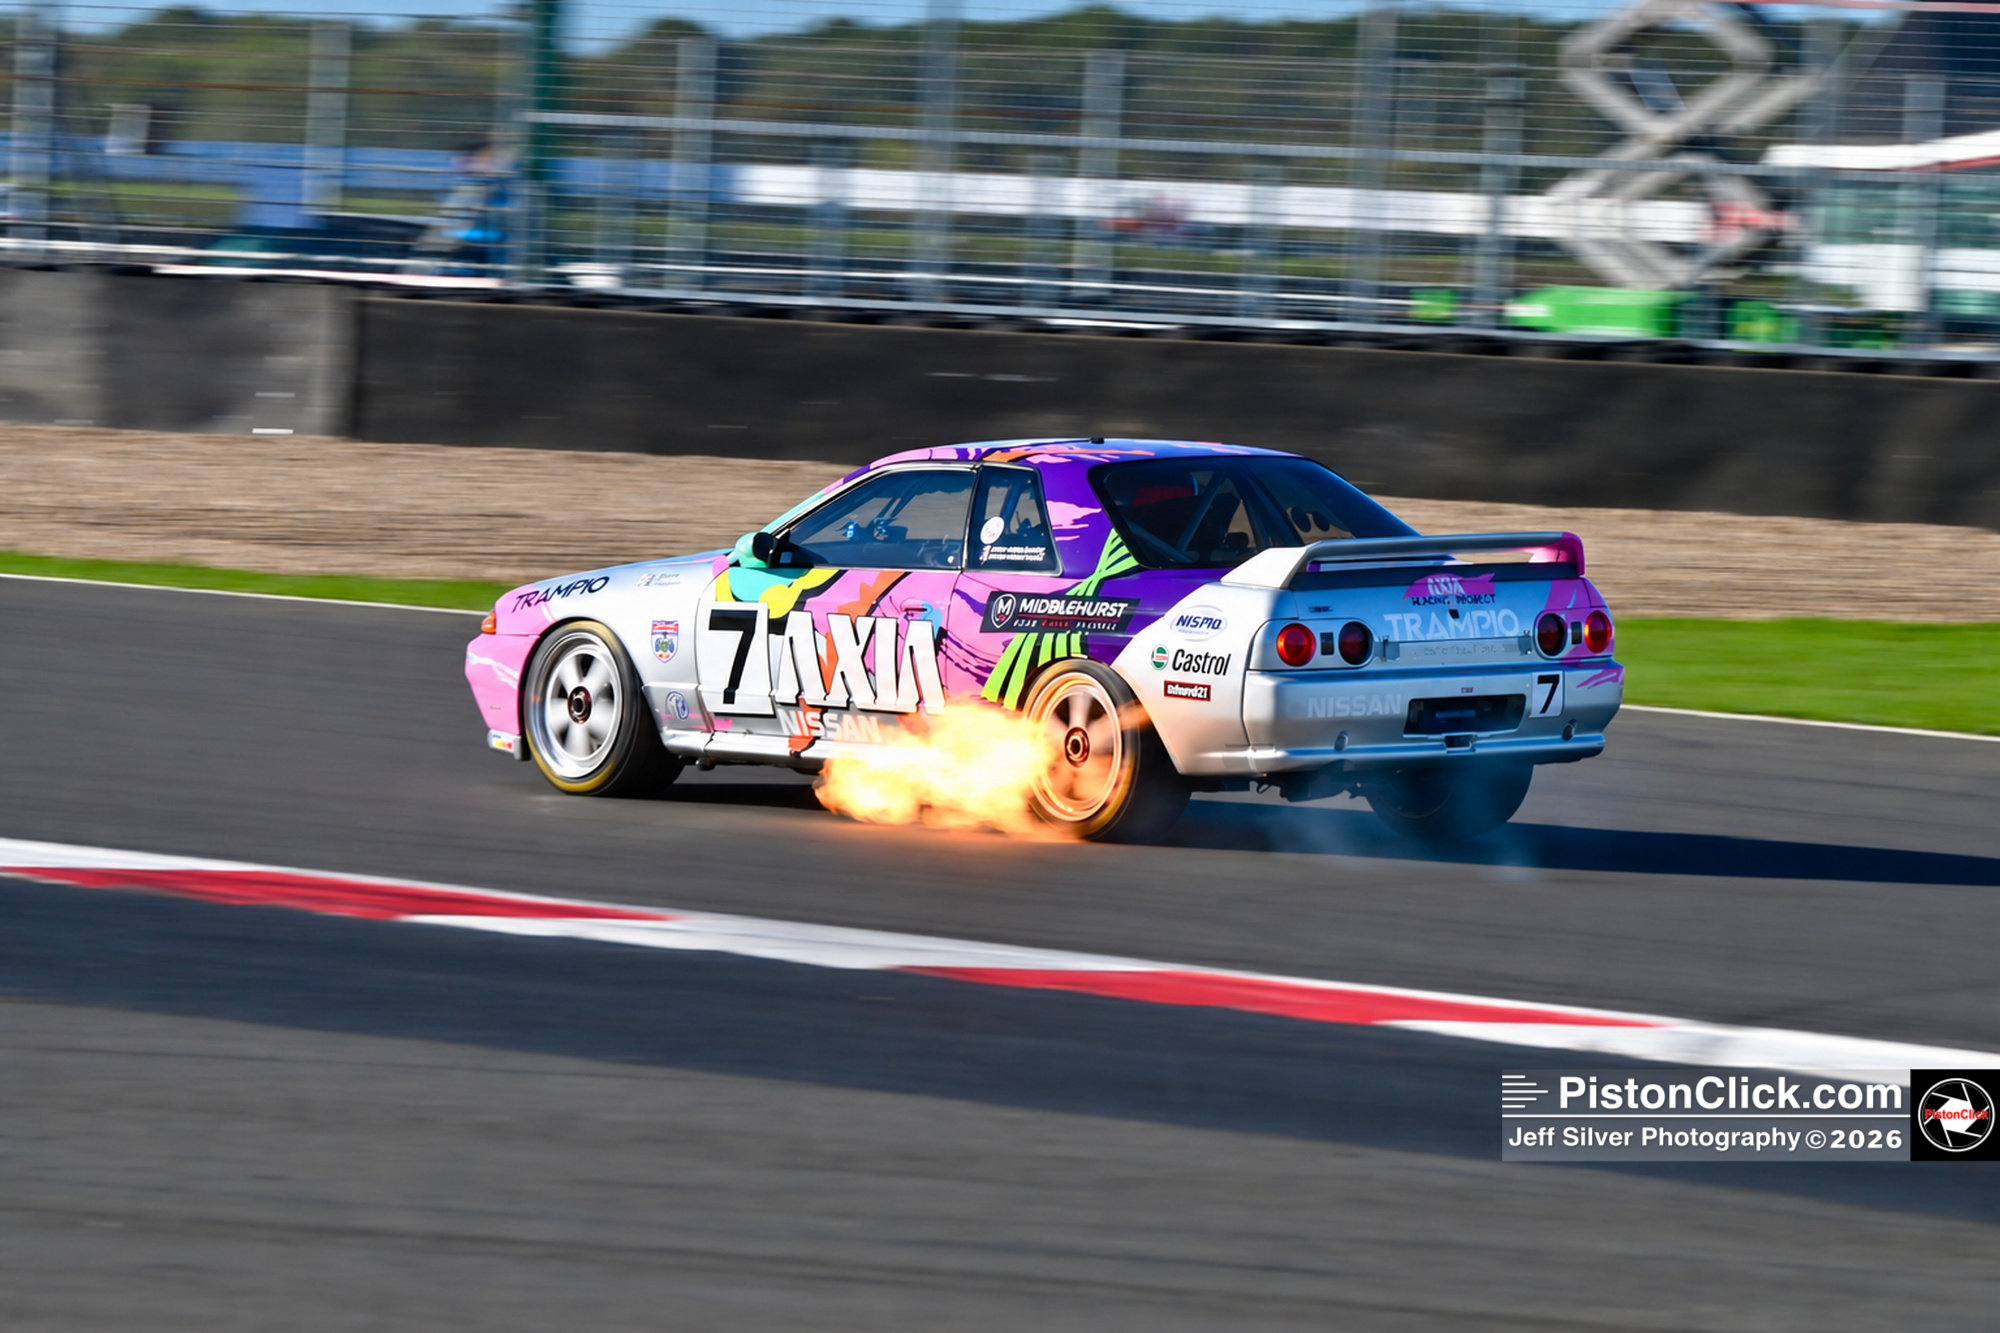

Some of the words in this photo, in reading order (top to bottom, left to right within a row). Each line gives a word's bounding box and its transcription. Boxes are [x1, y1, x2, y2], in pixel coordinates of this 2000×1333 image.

[512, 576, 610, 613] TRAMPIO
[1018, 598, 1128, 618] MIDDLEHURST
[1176, 614, 1223, 630] NISMO
[1383, 608, 1520, 642] TRAMPIO
[708, 609, 758, 705] 7
[1172, 648, 1232, 676] Castrol
[1307, 693, 1403, 719] NISSAN
[1537, 674, 1560, 714] 7
[776, 708, 883, 743] NISSAN
